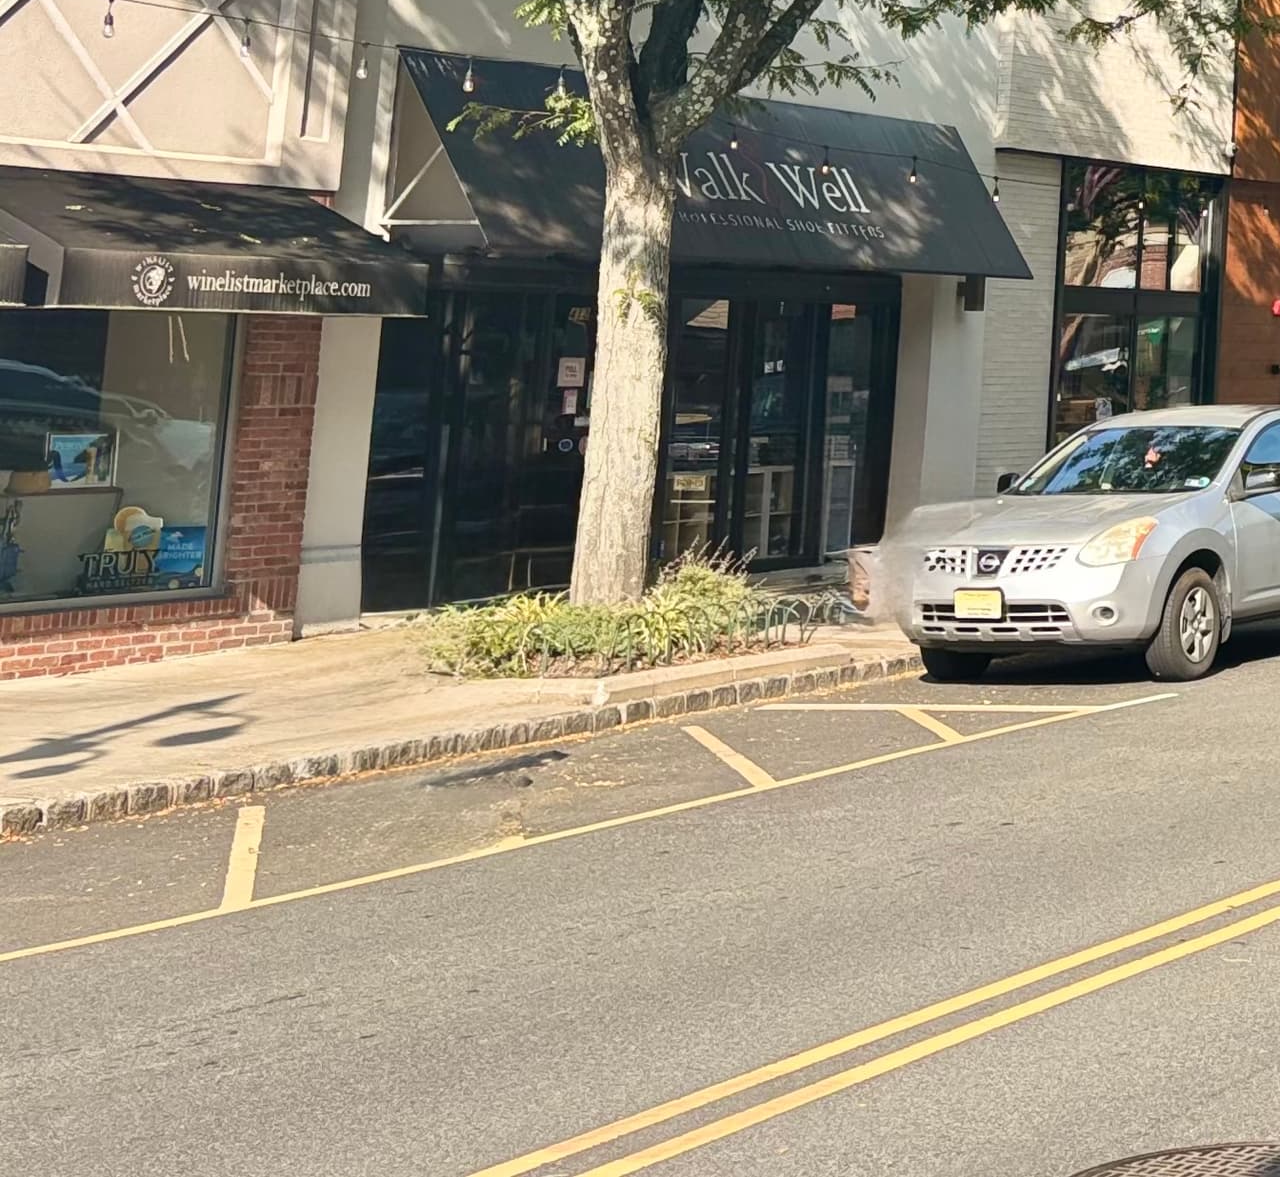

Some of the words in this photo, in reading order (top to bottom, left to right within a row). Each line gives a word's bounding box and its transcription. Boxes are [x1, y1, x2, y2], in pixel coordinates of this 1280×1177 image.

[765, 161, 872, 214] Well
[187, 269, 372, 301] winelistmarketplace.com
[81, 551, 158, 579] TRULY
